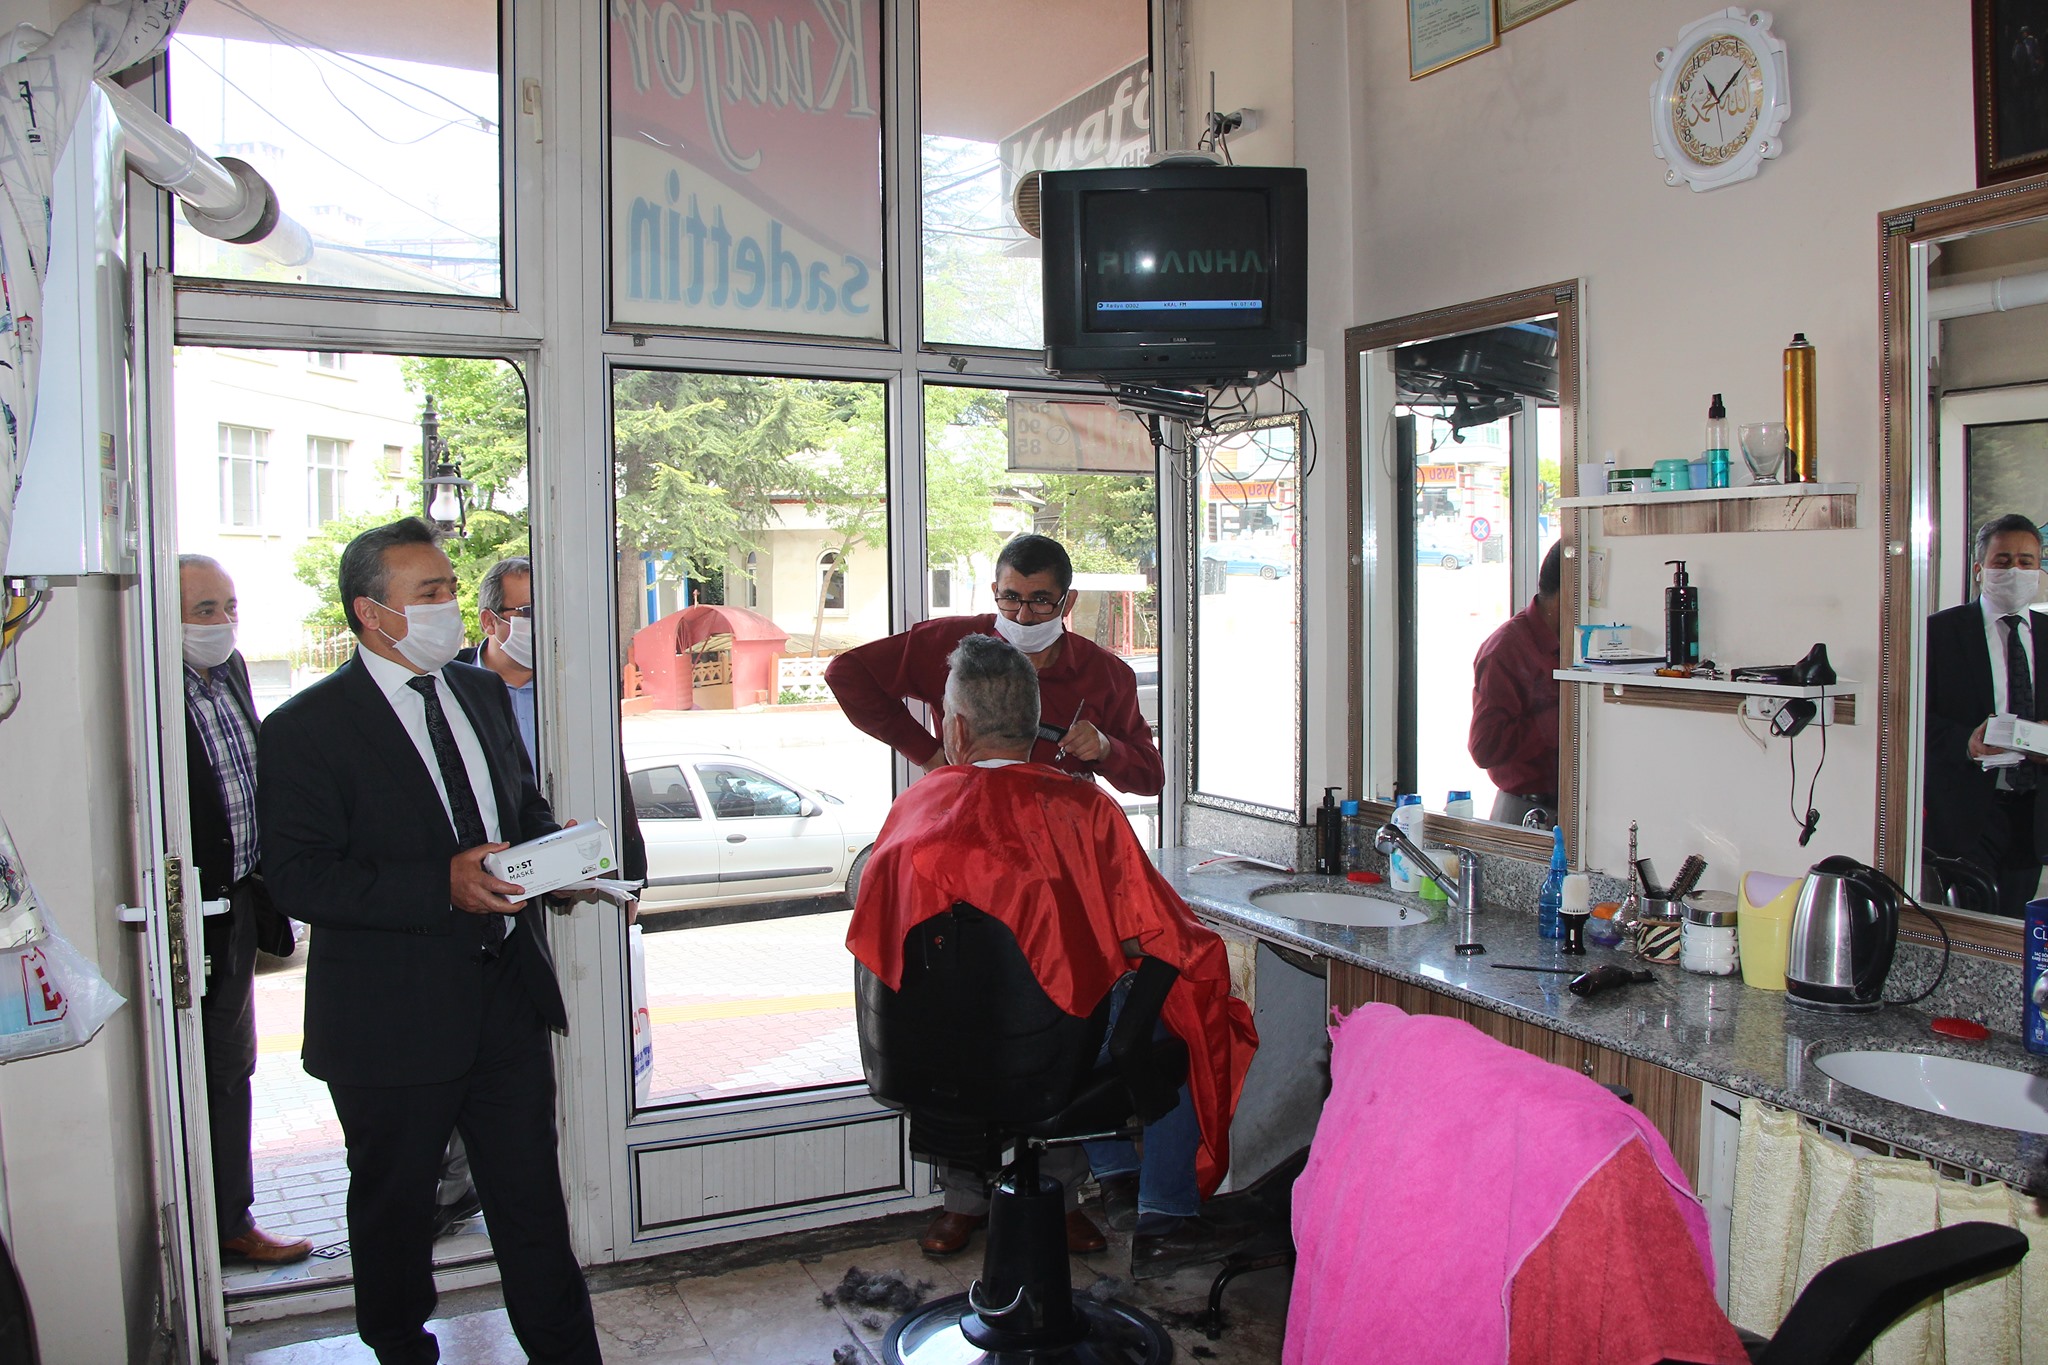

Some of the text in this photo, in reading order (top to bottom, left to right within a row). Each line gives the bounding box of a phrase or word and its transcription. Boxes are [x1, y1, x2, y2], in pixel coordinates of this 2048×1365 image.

[1710, 41, 1721, 56] 12
[1098, 250, 1263, 274] PIRANHA
[507, 860, 532, 873] DOST
[509, 868, 535, 881] MASKE
